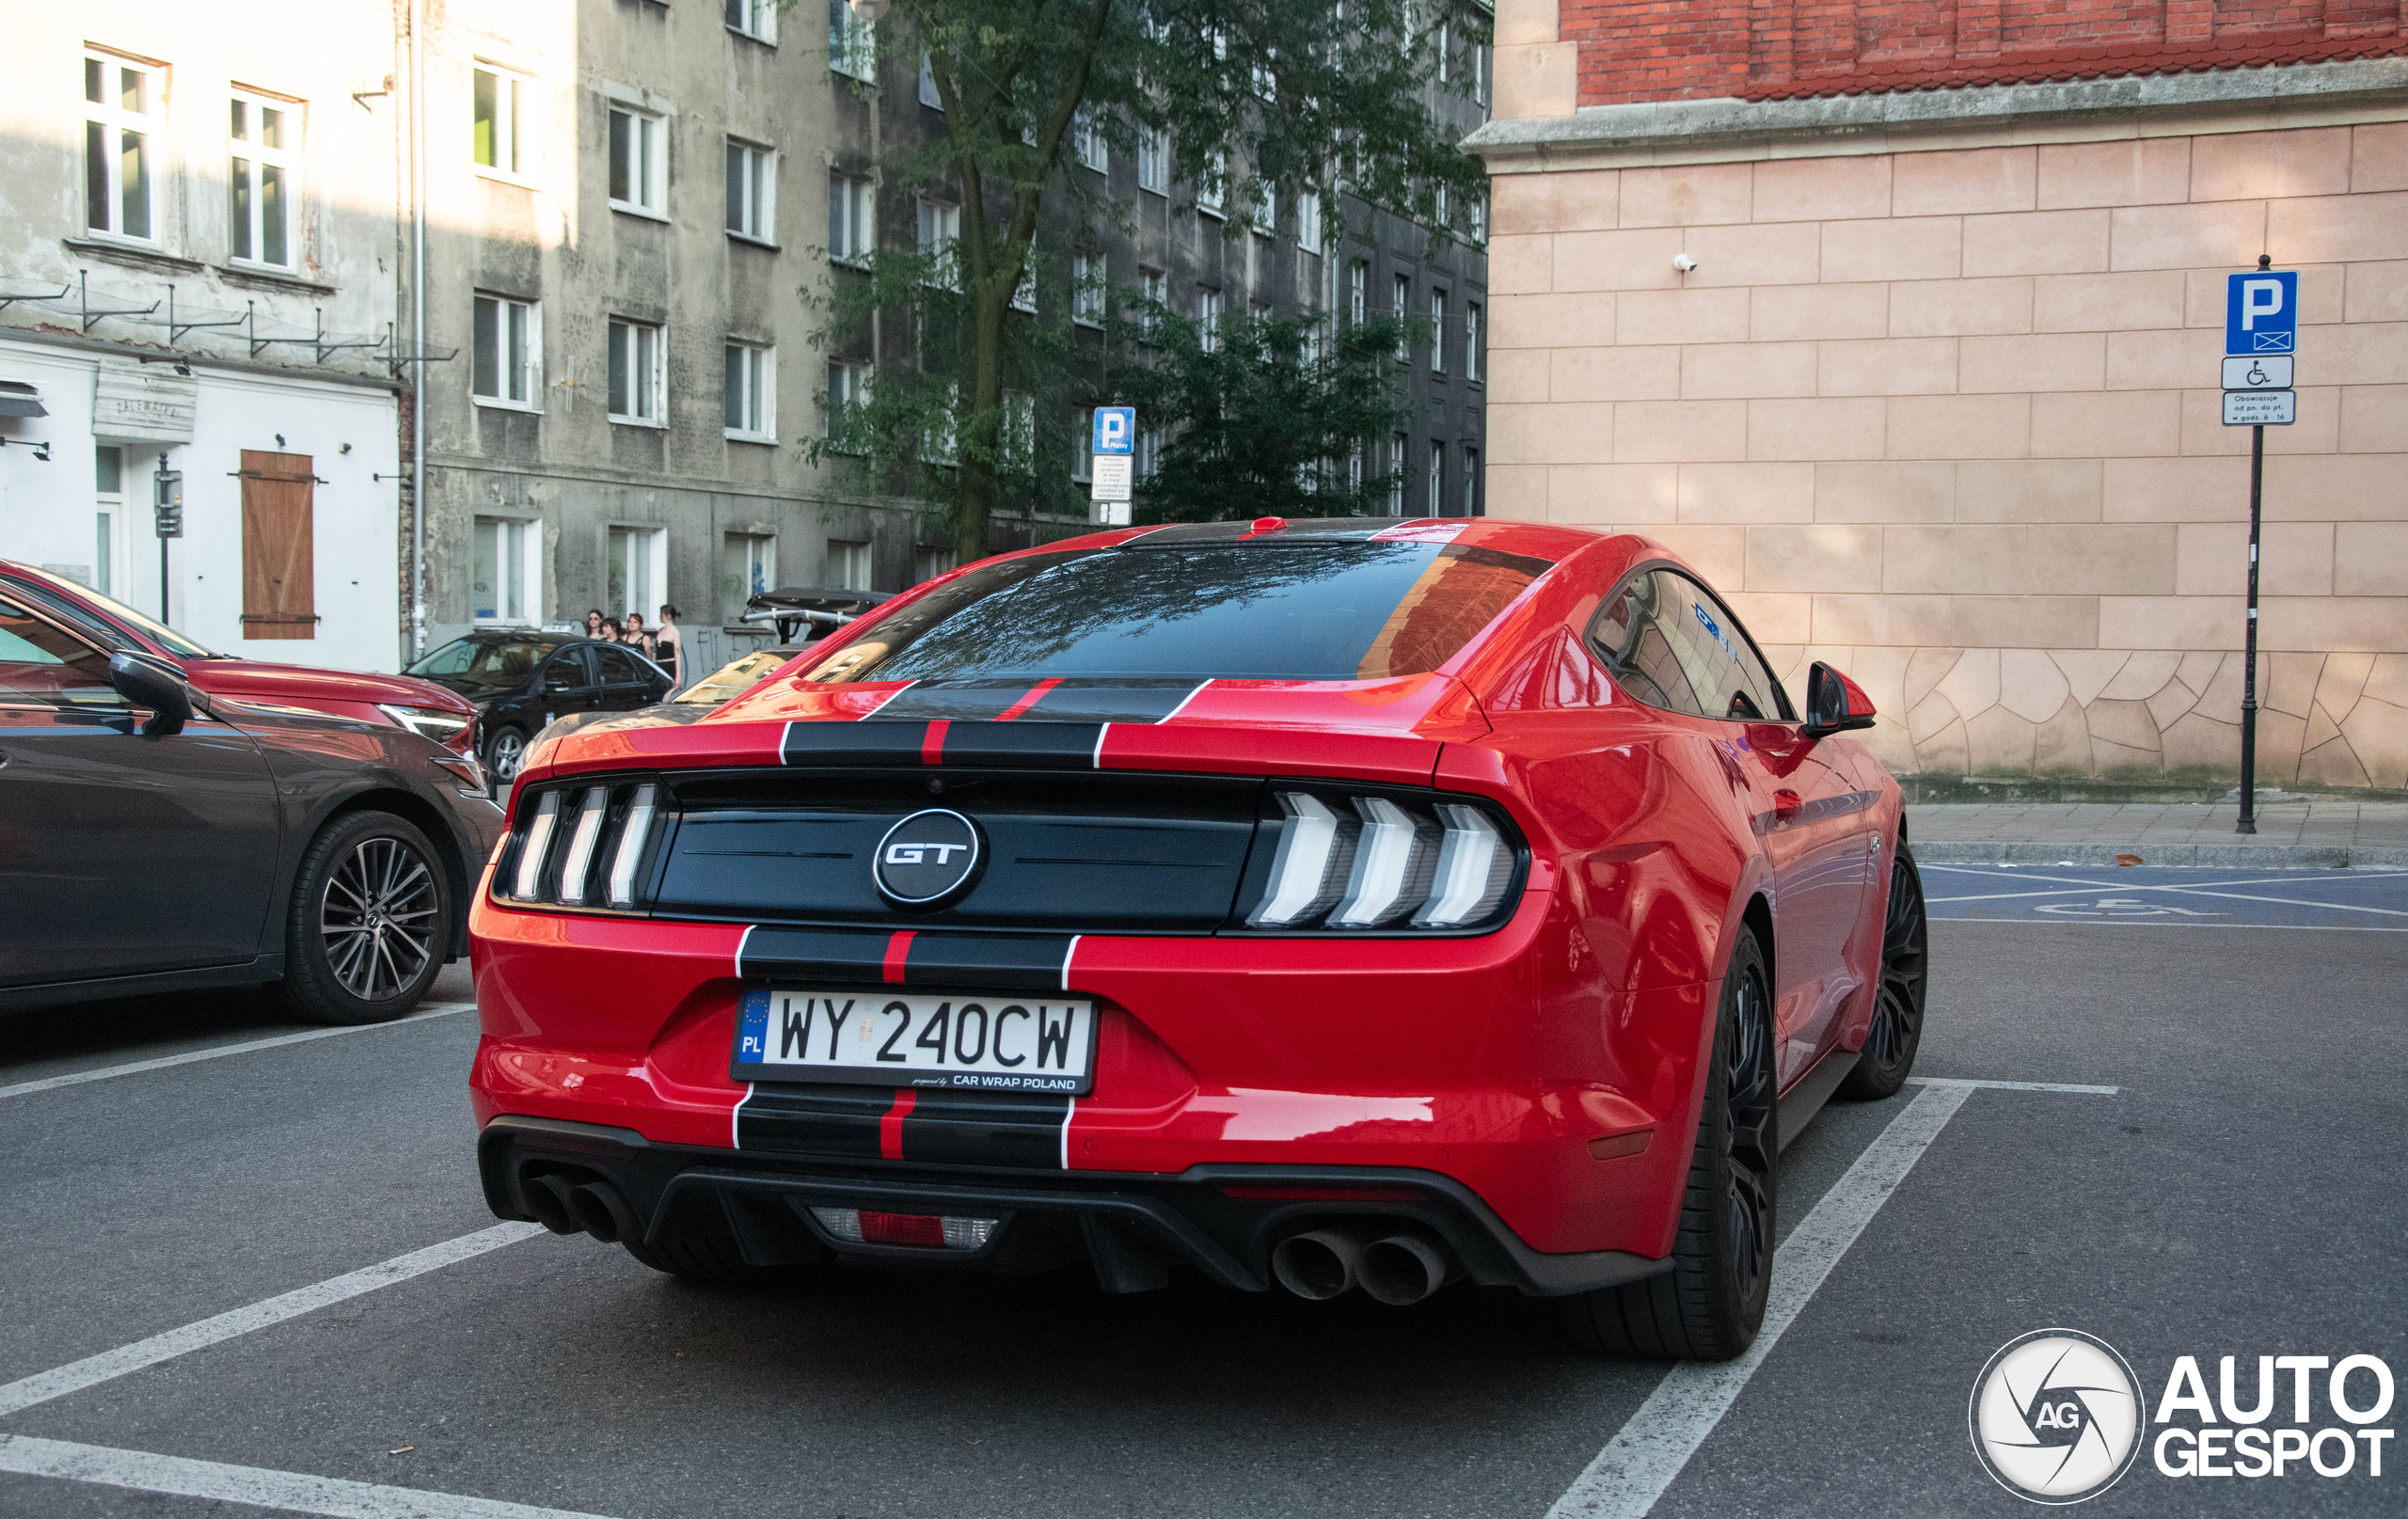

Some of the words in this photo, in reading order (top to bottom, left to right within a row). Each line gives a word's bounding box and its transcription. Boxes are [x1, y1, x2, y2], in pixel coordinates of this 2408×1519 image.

[2242, 278, 2284, 331] P
[1101, 413, 1125, 449] P
[885, 843, 968, 865] GT
[741, 1036, 762, 1053] PL
[780, 998, 855, 1060] WY
[876, 1000, 1075, 1069] 240CW
[912, 1078, 939, 1086] prepared
[953, 1075, 978, 1085] CAR
[981, 1076, 1021, 1087] WRAP
[1022, 1078, 1076, 1089] POLAND
